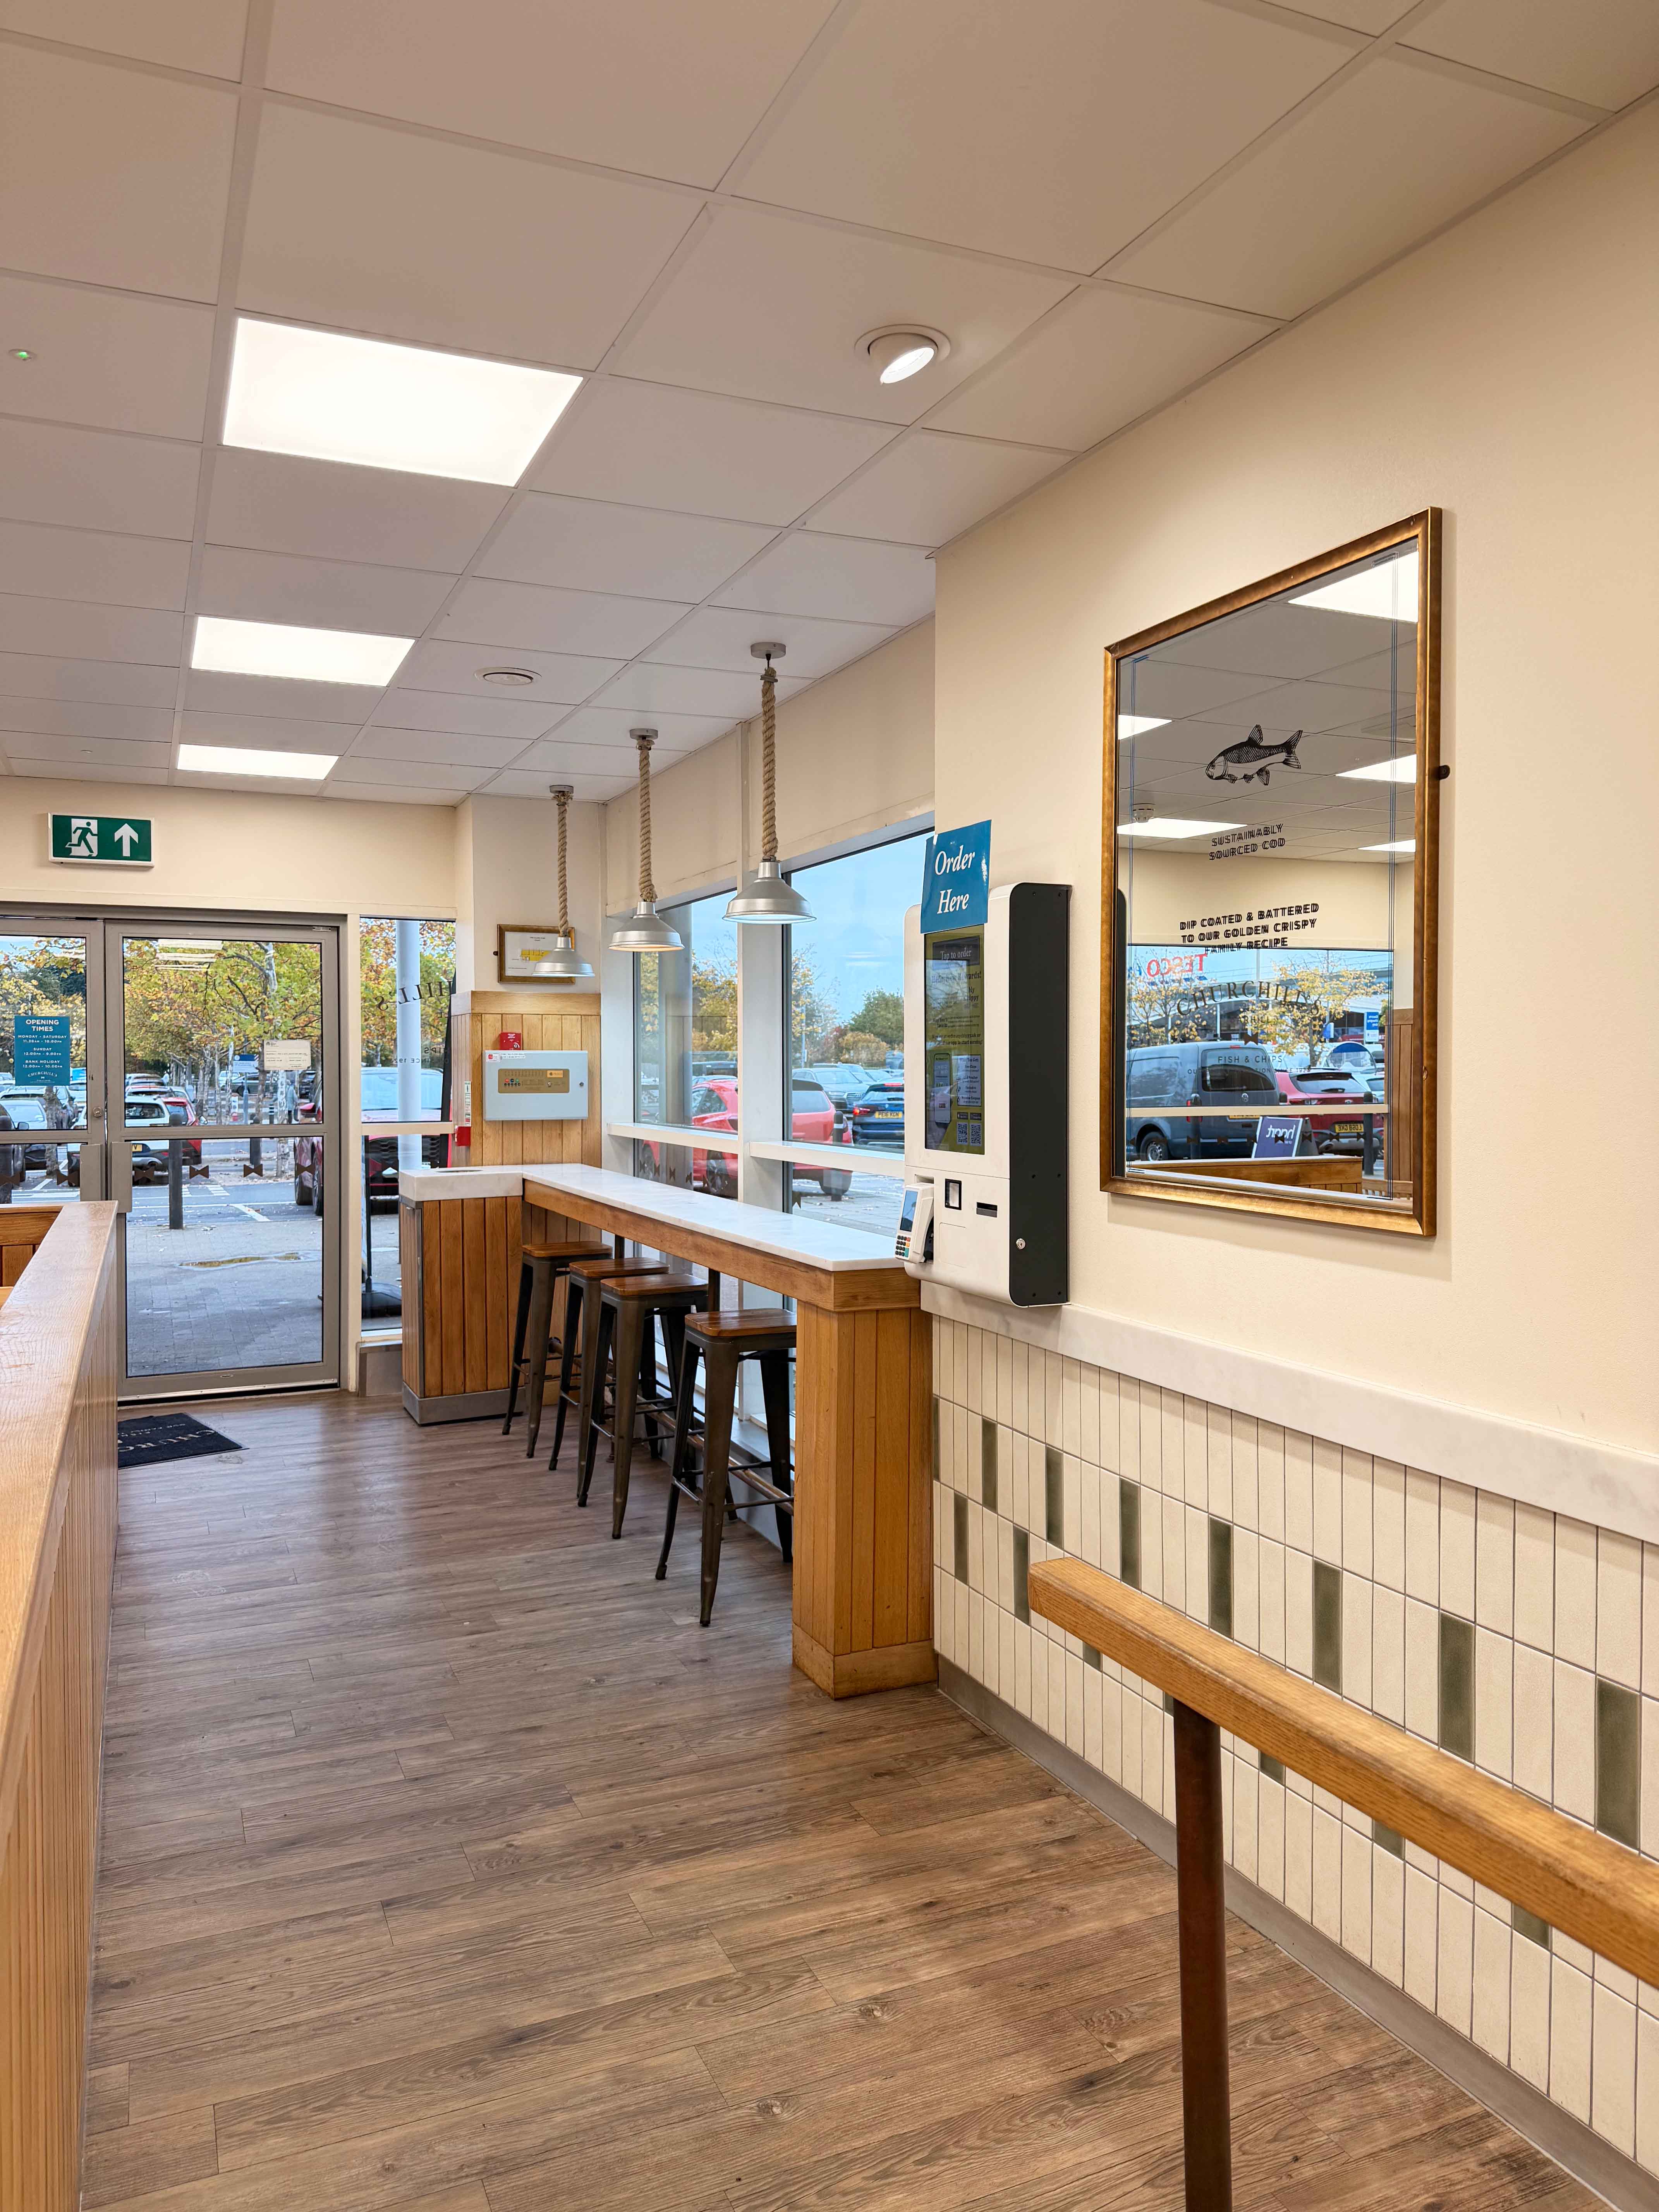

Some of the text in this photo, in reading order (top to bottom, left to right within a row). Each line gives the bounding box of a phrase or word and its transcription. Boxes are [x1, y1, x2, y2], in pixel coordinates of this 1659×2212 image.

[1211, 824, 1283, 847] SUSTAINABLY
[935, 845, 975, 875] Order
[1209, 837, 1286, 860] SOURCED COD
[937, 889, 970, 914] Here
[1180, 903, 1319, 931] DIP COATED & BATTERED
[1181, 918, 1317, 943] TO OUR GOLDEN CRISPY
[940, 951, 950, 962] Tap
[957, 947, 972, 958] order
[1247, 937, 1288, 950] RECIPE
